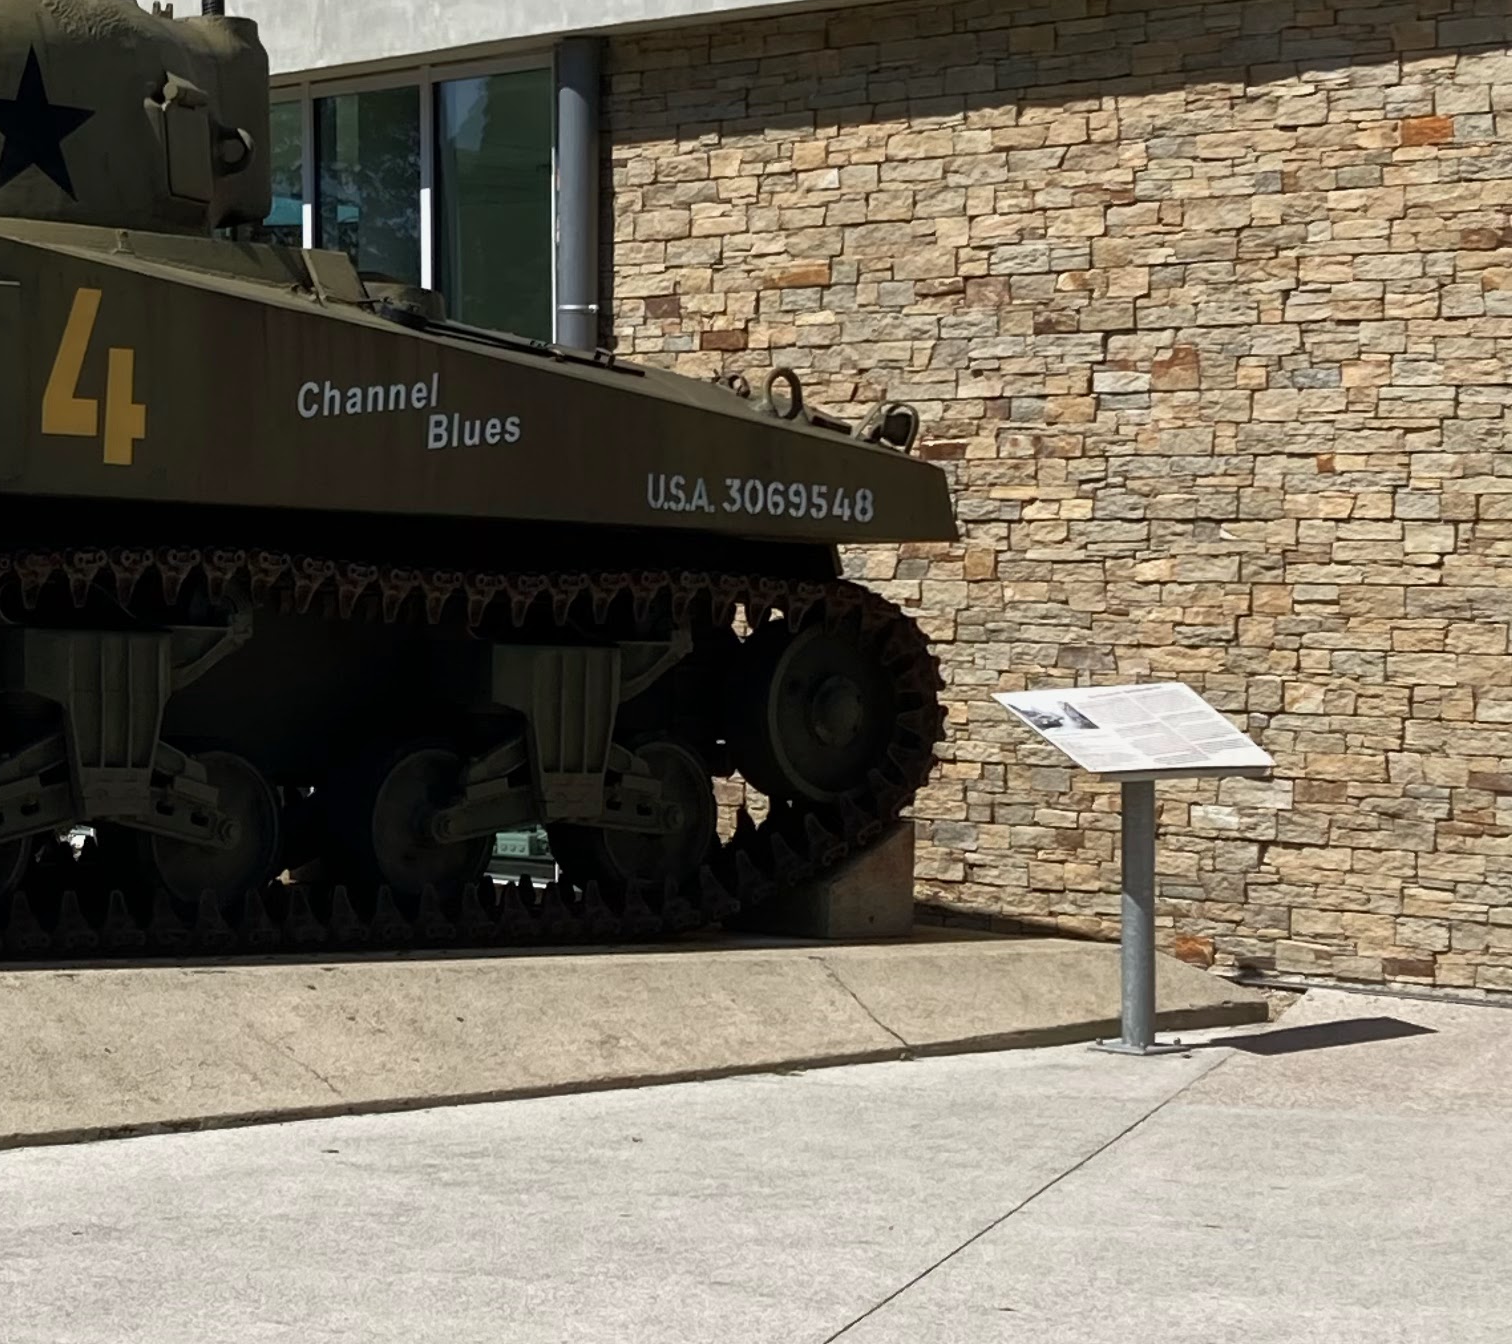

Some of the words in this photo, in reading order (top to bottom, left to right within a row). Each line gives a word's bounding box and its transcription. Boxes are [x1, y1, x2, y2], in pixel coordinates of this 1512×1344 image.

[41, 287, 147, 466] 4
[297, 371, 440, 419] Channel
[427, 412, 522, 450] Blues
[722, 477, 875, 523] 3069548
